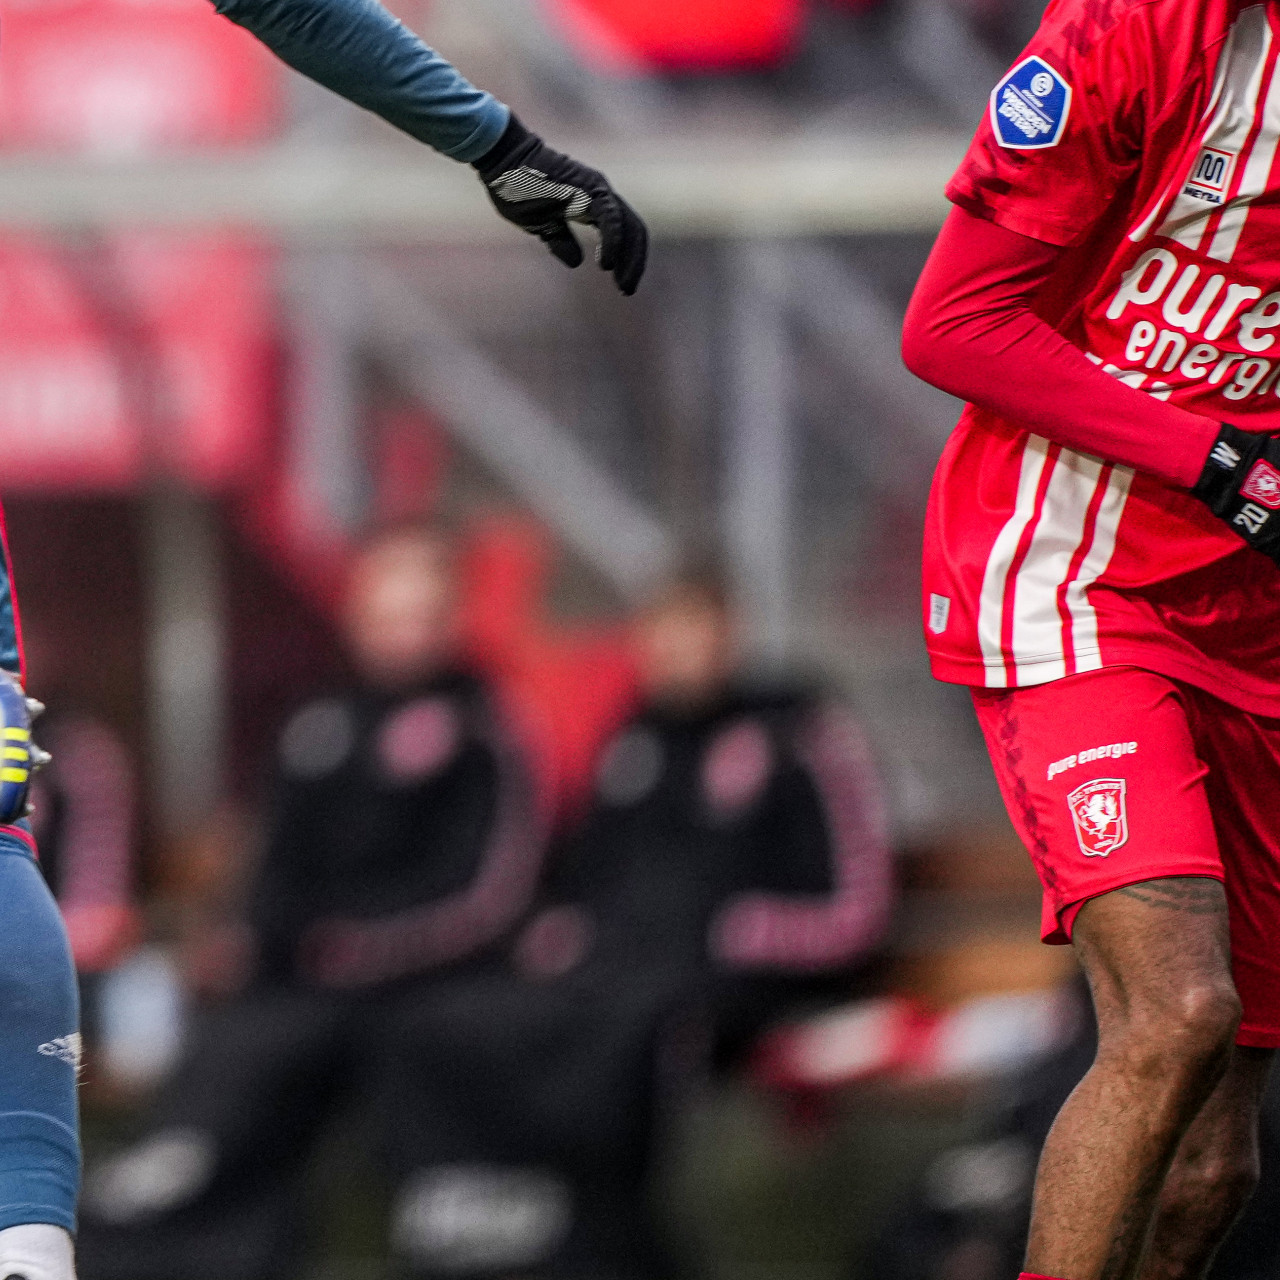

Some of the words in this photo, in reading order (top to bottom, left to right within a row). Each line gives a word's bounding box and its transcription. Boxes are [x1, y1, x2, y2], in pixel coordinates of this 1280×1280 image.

[1105, 247, 1280, 352] pure
[1124, 320, 1280, 401] energi
[1233, 502, 1270, 534] 20
[1047, 754, 1078, 781] pure
[1078, 741, 1138, 759] energie
